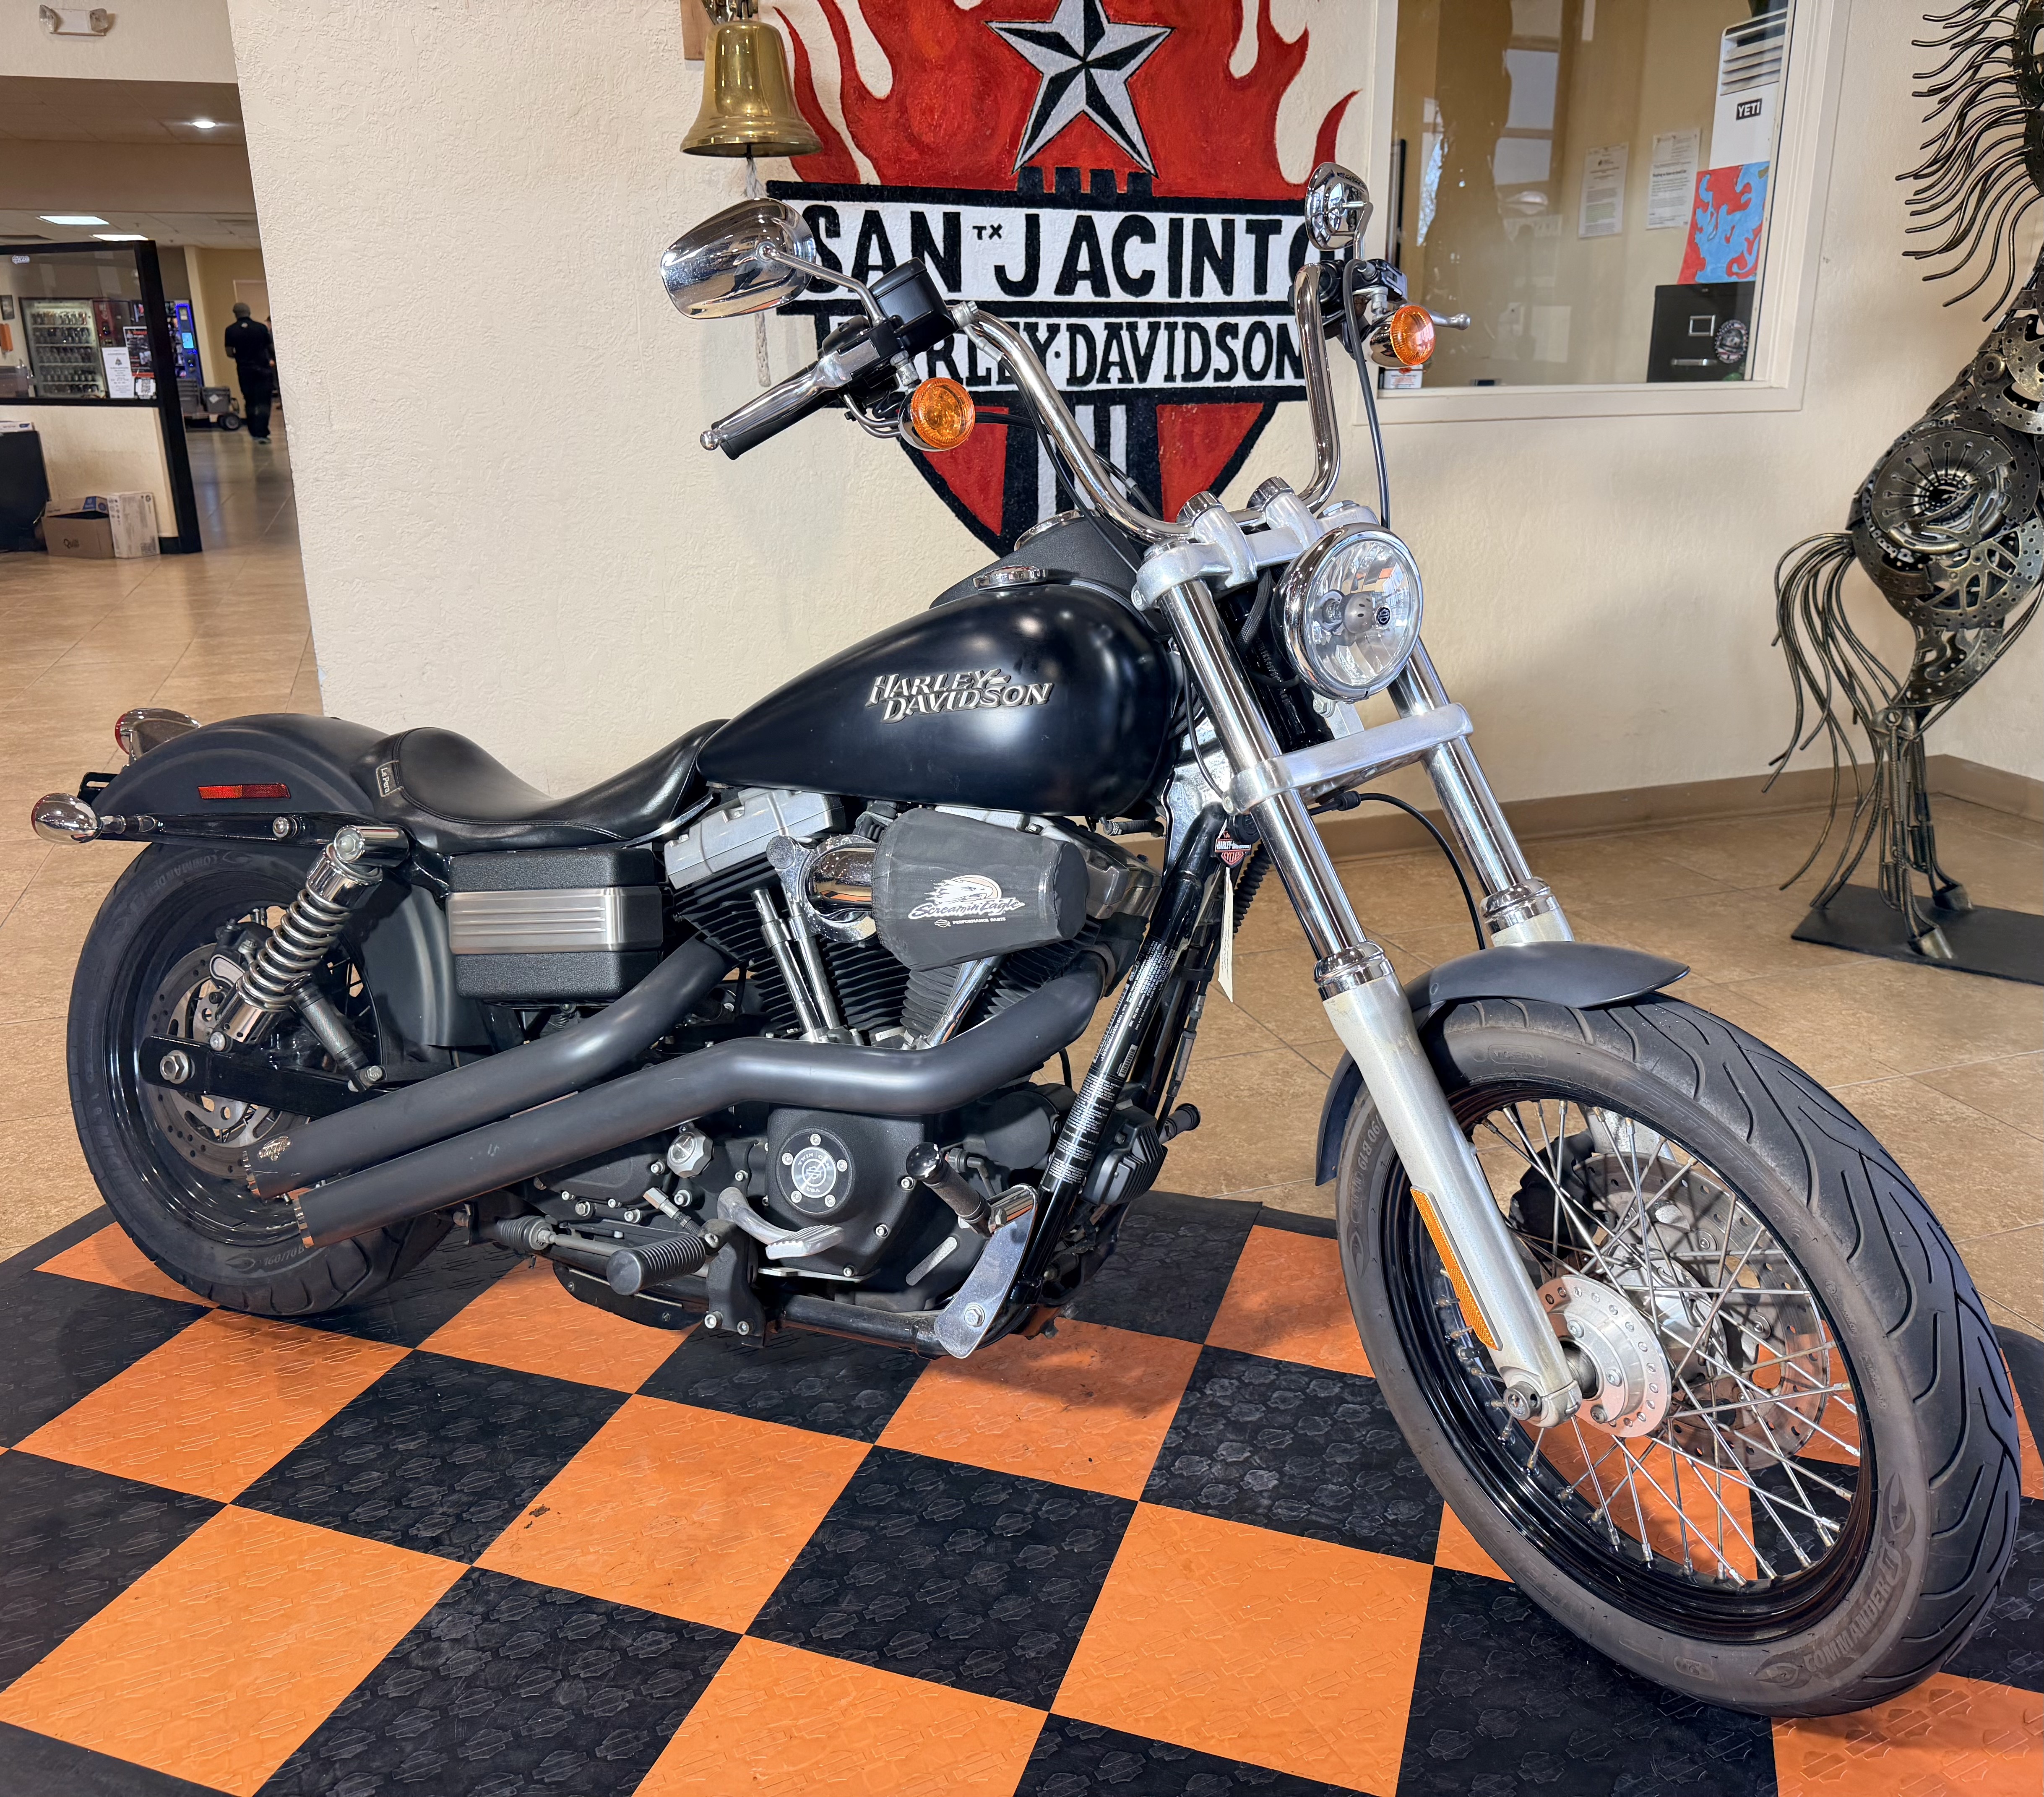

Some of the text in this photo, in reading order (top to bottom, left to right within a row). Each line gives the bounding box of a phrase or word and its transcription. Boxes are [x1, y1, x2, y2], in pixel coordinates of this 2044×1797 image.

[1738, 102, 1760, 117] YETI
[802, 204, 962, 294] SAN
[972, 223, 1003, 240] TX
[865, 668, 1011, 708] HARLEY-
[881, 682, 1054, 724] DAVIDSON
[979, 897, 1025, 916] Eagle
[798, 1152, 814, 1165] TWIN
[263, 1249, 296, 1266] 160/70
[1803, 1580, 1892, 1673] COMMANDER
